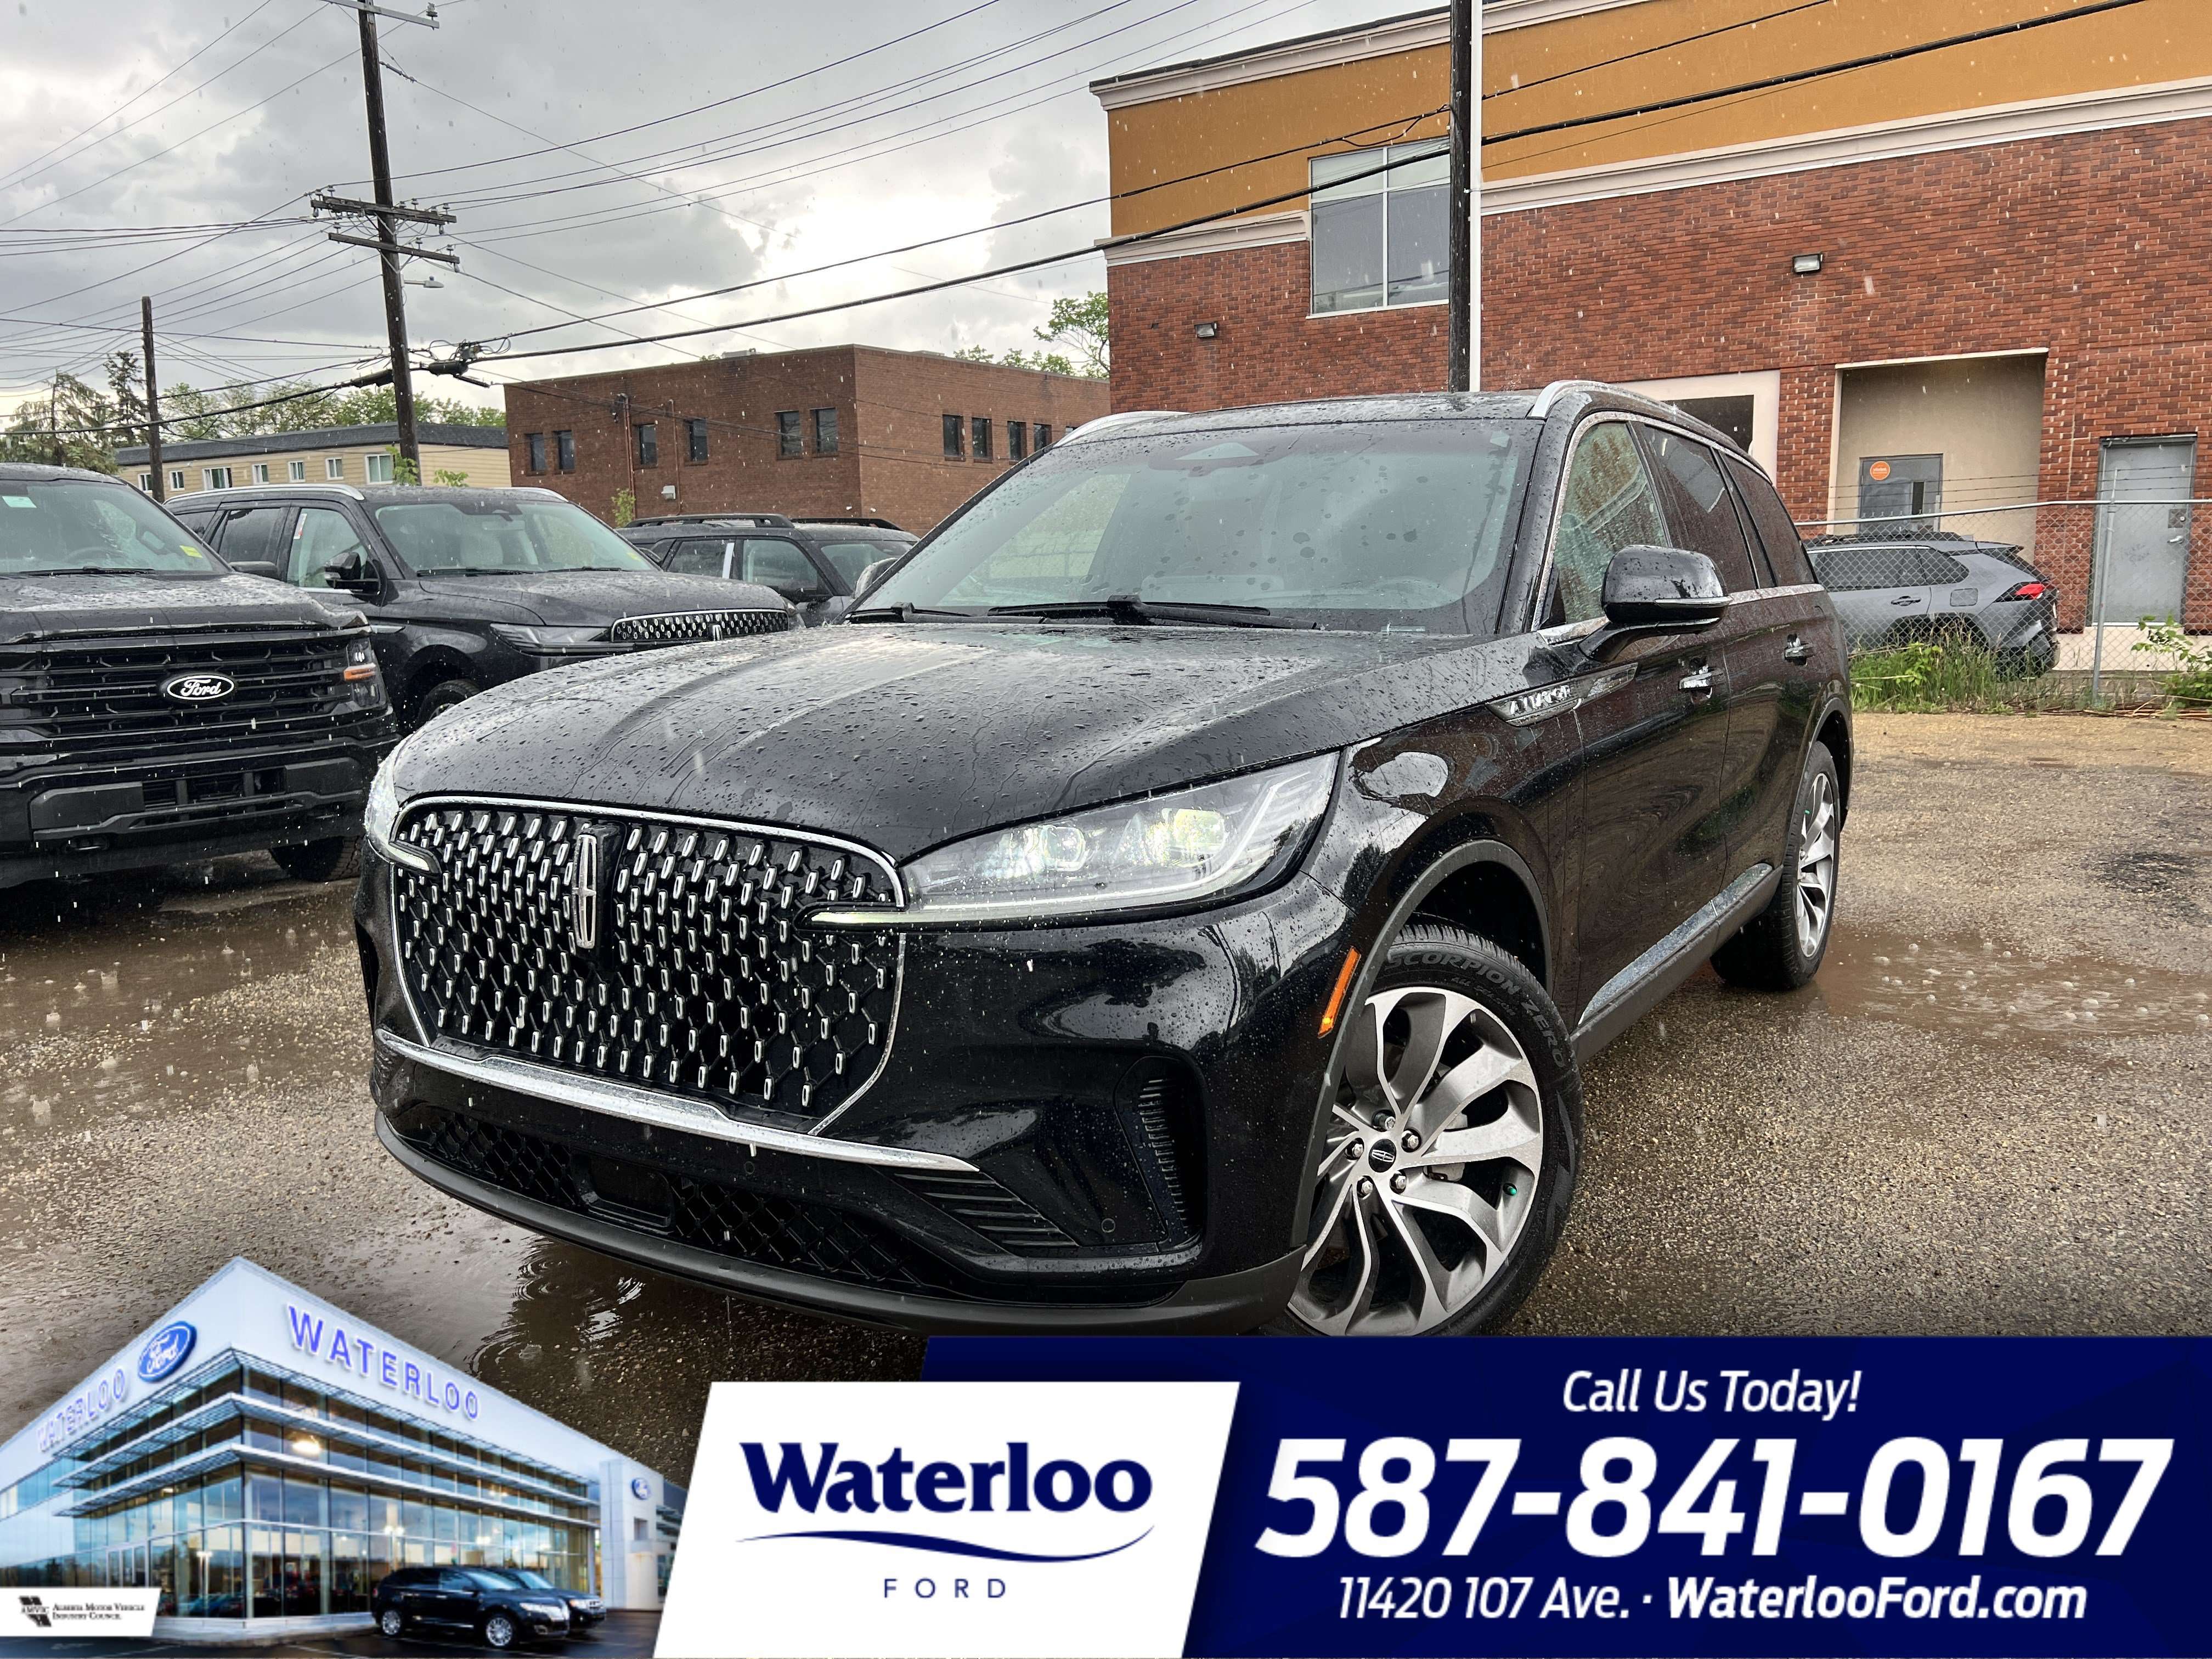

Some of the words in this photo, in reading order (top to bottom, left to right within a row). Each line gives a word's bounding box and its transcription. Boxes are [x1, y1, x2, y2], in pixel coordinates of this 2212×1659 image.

[180, 679, 222, 697] Ford
[1385, 951, 1521, 995] SCORPION
[1521, 998, 1565, 1068] ZERO
